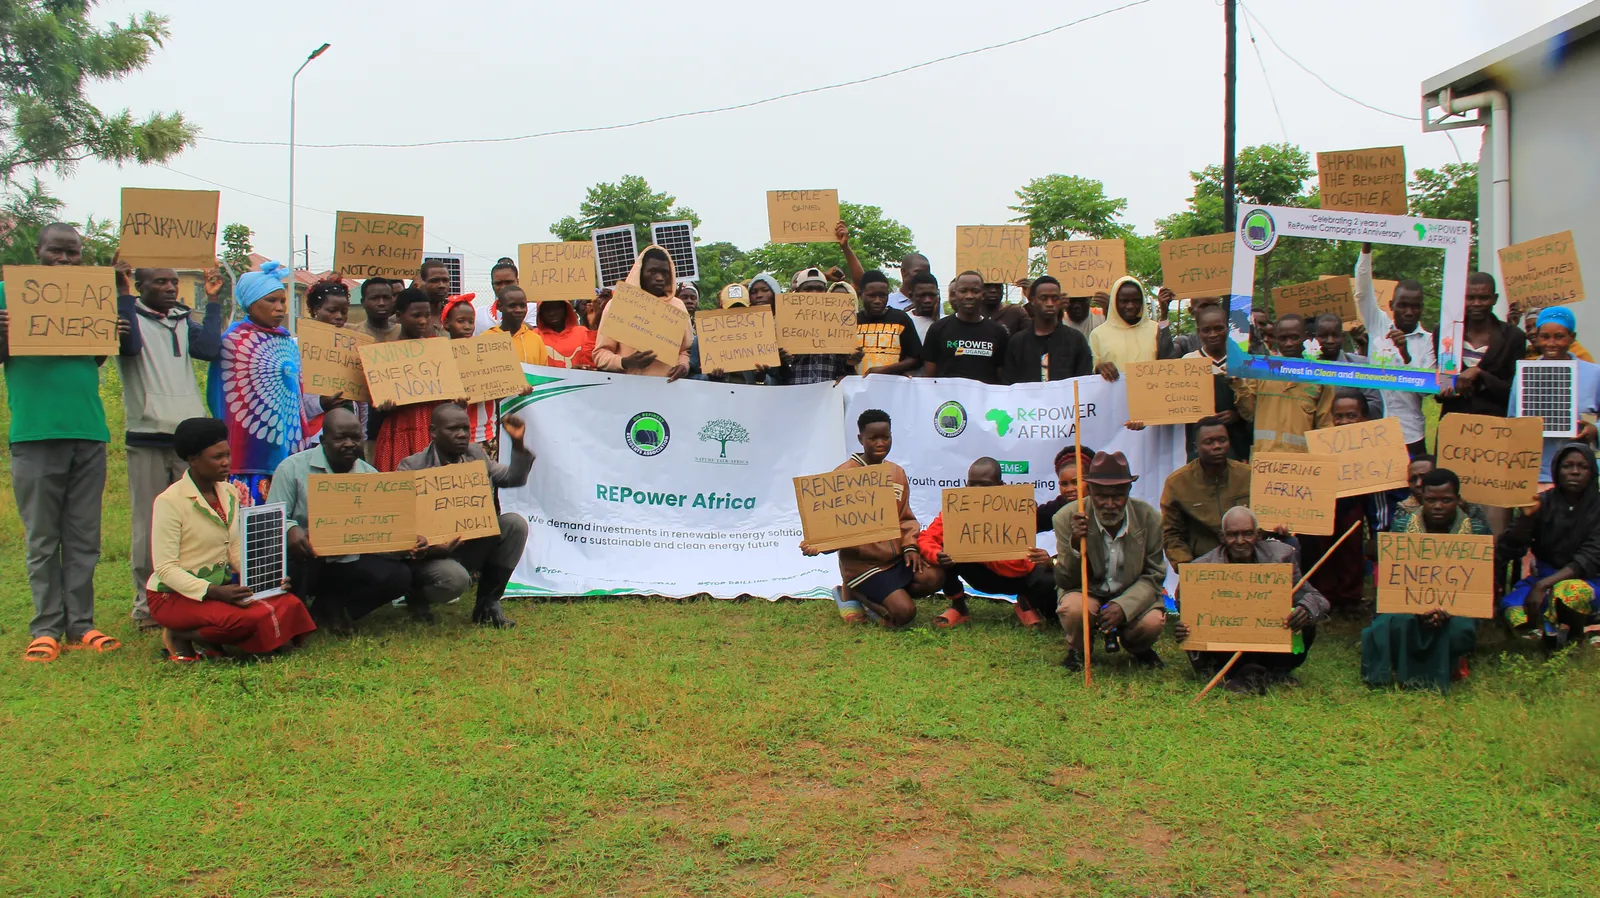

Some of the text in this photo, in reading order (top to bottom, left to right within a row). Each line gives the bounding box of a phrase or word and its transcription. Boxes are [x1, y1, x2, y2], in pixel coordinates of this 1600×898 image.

[1320, 154, 1396, 170] SHARING IN
[1324, 173, 1405, 188] THE BENEFITS
[340, 216, 423, 239] ENERGY
[783, 221, 829, 234] POWER
[1287, 221, 1317, 231] RePower
[1360, 220, 1379, 229] years
[1380, 220, 1387, 228] of
[1428, 224, 1467, 235] REPOWER
[962, 227, 1024, 251] SOLAR
[1427, 235, 1457, 245] AFRIKA
[343, 242, 422, 260] IS A RIGHT
[531, 243, 595, 264] REPOWER
[1051, 244, 1099, 259] CLEAN
[957, 251, 1025, 268] ENERGY
[1059, 260, 1113, 273] ENERGY
[341, 265, 367, 275] NOT
[530, 268, 587, 286] AFRIKA
[1178, 267, 1228, 283] AFRIKA
[21, 279, 116, 314] SOLAR
[1281, 282, 1328, 299] CLEAN
[782, 294, 856, 308] REPOWERING
[1299, 292, 1348, 308] ENERGY
[701, 312, 766, 333] ENERGY
[794, 308, 840, 324] AFRIKA
[704, 330, 763, 343] ACCESS IS
[781, 327, 820, 339] BEGINS
[827, 327, 855, 340] WITH
[334, 333, 359, 353] FOR
[477, 341, 512, 353] ENERGY
[812, 339, 826, 349] US
[946, 340, 993, 350] REPOWER
[361, 340, 424, 364] WIND
[704, 352, 716, 366] A
[720, 345, 755, 363] HUMAN
[367, 361, 442, 385] ENERGY
[459, 365, 514, 379] OMMUNITIES
[1136, 363, 1179, 378] SOLAR
[1280, 365, 1426, 386] Invest in Clean and Renewable Energy
[312, 374, 363, 396] ENERGY
[395, 379, 442, 400] NOW
[1147, 382, 1159, 390] ON
[1165, 394, 1198, 403] CLINICS
[1018, 423, 1077, 439] AFRIKA
[1317, 424, 1391, 454] SOLAR
[1460, 423, 1513, 439] NO TO
[1442, 444, 1541, 469] CORPORATE
[1337, 458, 1393, 481] ERGY
[317, 480, 415, 493] ENERGY ACCESS
[801, 471, 894, 498] RENEWABLE
[907, 476, 936, 487] Youth
[938, 479, 960, 487] and
[596, 484, 756, 510] REPower Africa
[1263, 481, 1313, 501] AFRIKA
[434, 495, 488, 511] ENERGY
[813, 490, 876, 512] ENERGY
[947, 493, 1036, 515] RE-POWER
[835, 508, 884, 528] NOW!
[1254, 505, 1325, 520] BEGINS WITH
[315, 515, 400, 528] ALL NOT JUST
[455, 516, 493, 532] NOW!
[528, 515, 544, 525] We
[547, 518, 591, 531] demand
[592, 523, 657, 537] investments
[659, 529, 670, 537] in
[672, 530, 727, 540] renewable
[729, 531, 766, 542] energy
[343, 532, 393, 544] WEALTHY
[960, 522, 1028, 545] AFRIKA
[564, 532, 779, 552] for a sustainable and clean energy future
[1381, 535, 1494, 561] RENEWABLE
[1185, 569, 1293, 585] MEETING HUMAN
[1389, 564, 1475, 591] ENERGY
[1211, 589, 1273, 600] NEEDS NOT
[1405, 586, 1457, 606] NOW
[1196, 613, 1248, 627] MARKET
